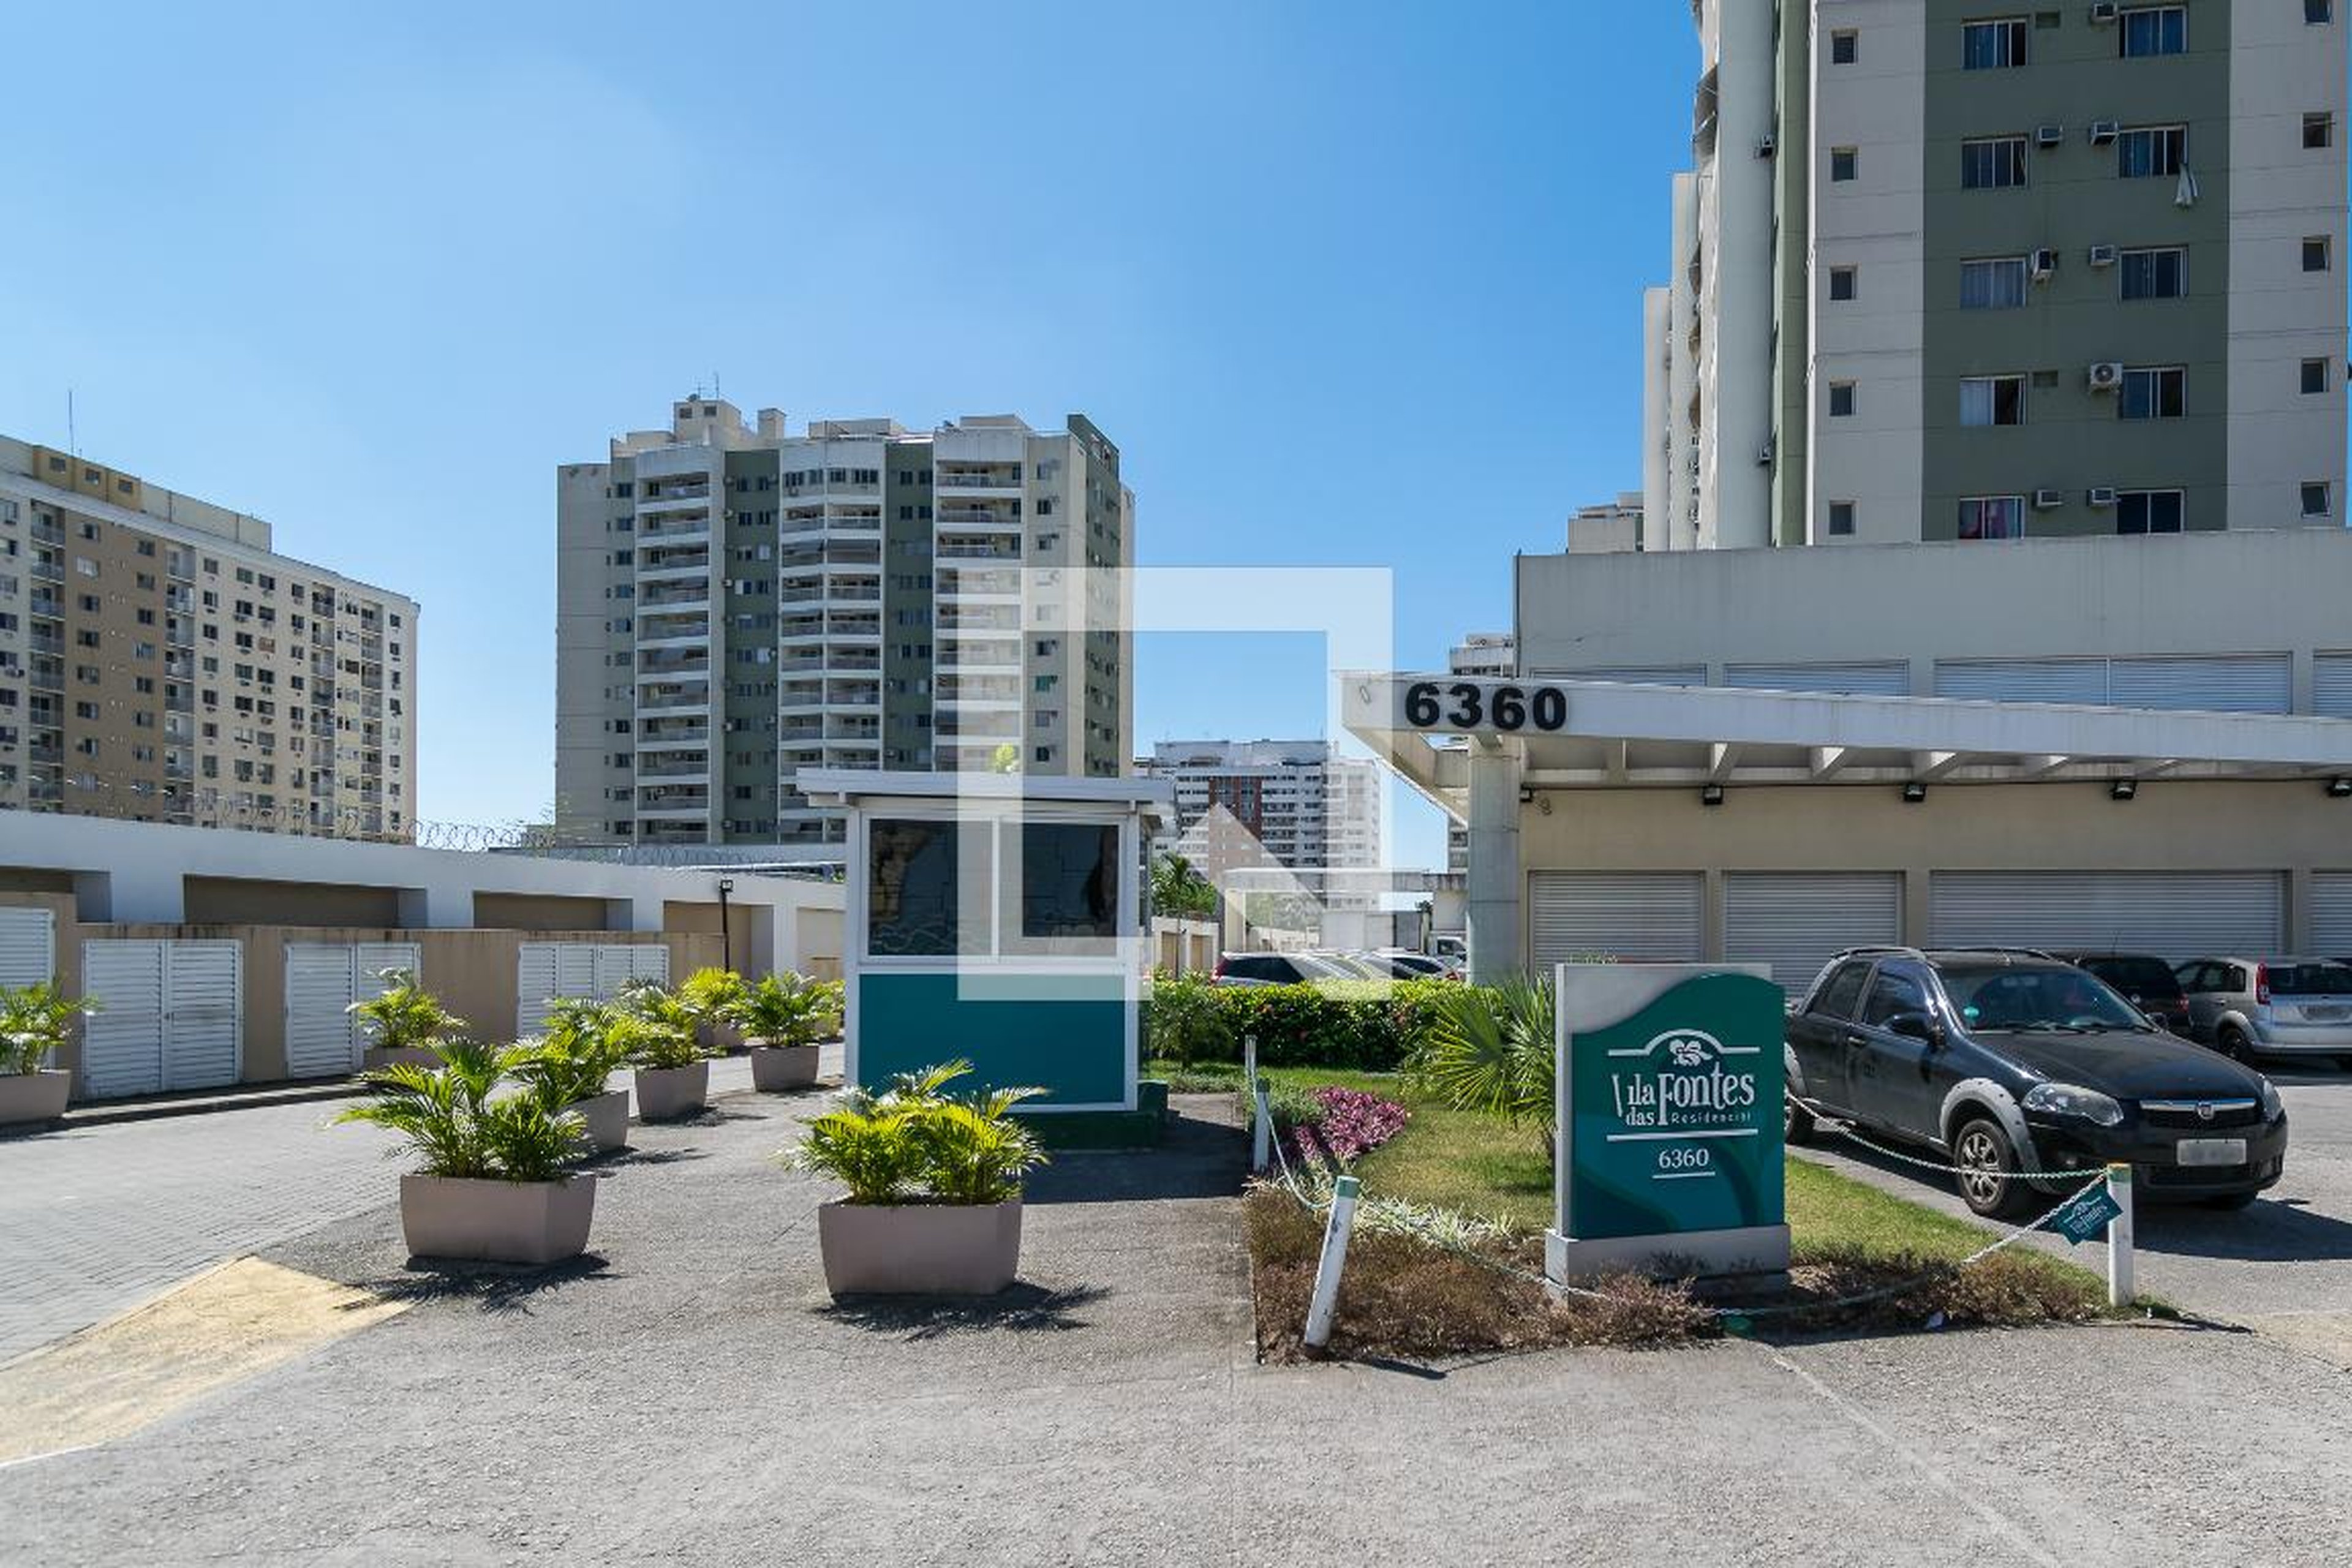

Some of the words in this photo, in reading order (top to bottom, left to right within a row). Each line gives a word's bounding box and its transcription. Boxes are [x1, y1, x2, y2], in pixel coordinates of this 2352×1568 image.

[1405, 682, 1566, 731] 6360
[1657, 1061, 1755, 1125] Fontes
[1626, 1106, 1654, 1126] das
[1672, 1112, 1751, 1123] Residencial
[1659, 1148, 1709, 1168] 6360
